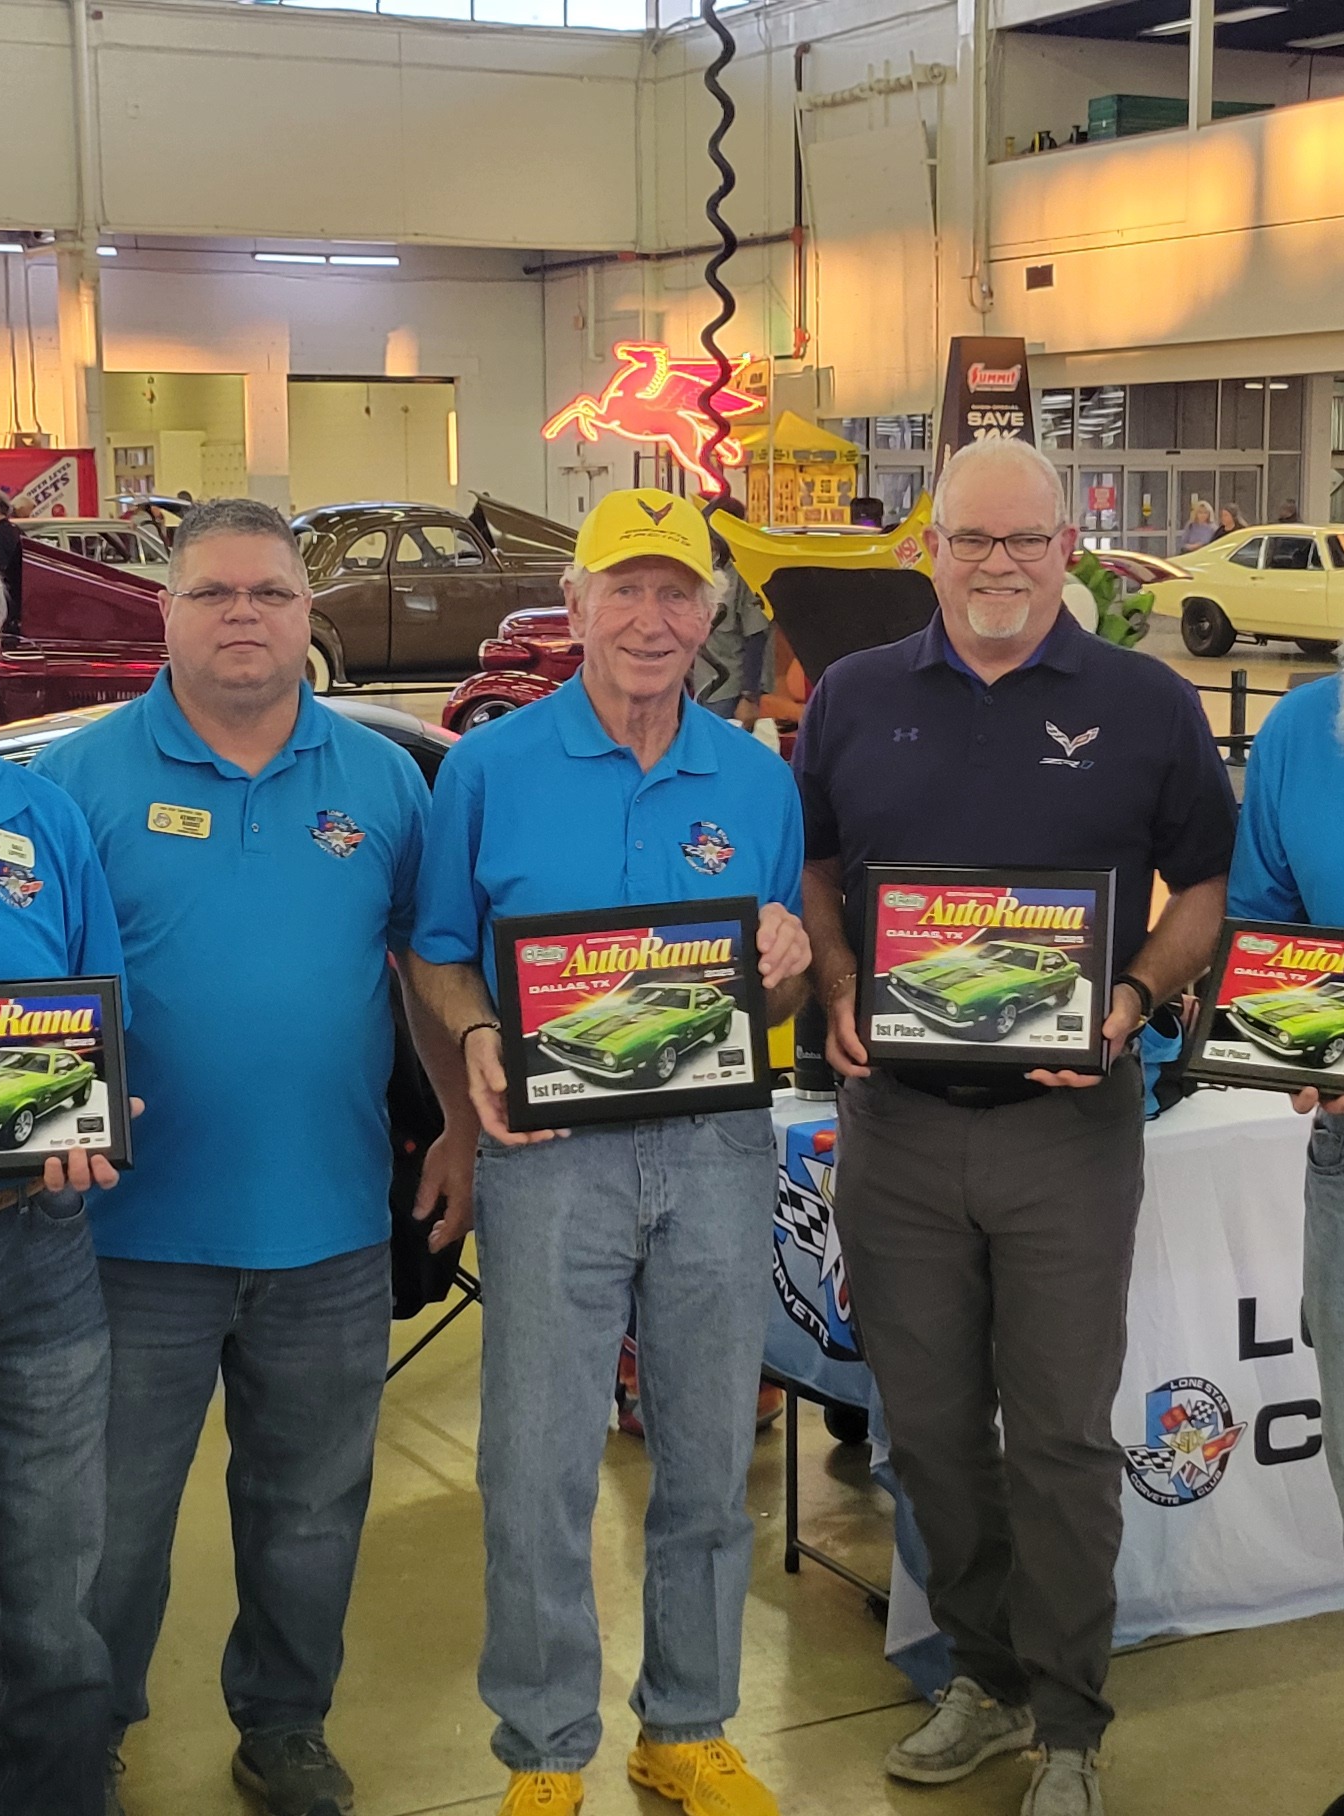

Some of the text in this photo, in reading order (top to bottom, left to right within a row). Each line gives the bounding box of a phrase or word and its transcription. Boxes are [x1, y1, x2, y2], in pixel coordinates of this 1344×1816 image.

[967, 411, 1024, 426] SAVE
[33, 472, 70, 507] KETS
[893, 536, 918, 565] MSD
[916, 895, 1087, 930] AutoRama
[885, 929, 963, 939] DALLAS, TX
[559, 937, 733, 978] AutoRama
[528, 979, 611, 994] DALLAS, TX
[1233, 967, 1308, 982] DALLAS, TX
[875, 1022, 926, 1038] 1st Place
[532, 1081, 585, 1098] 1st Place
[773, 1246, 830, 1348] ORVETTE
[1170, 1379, 1229, 1413] LONE STAR
[1130, 1470, 1222, 1504] CORVETTE CLUB
